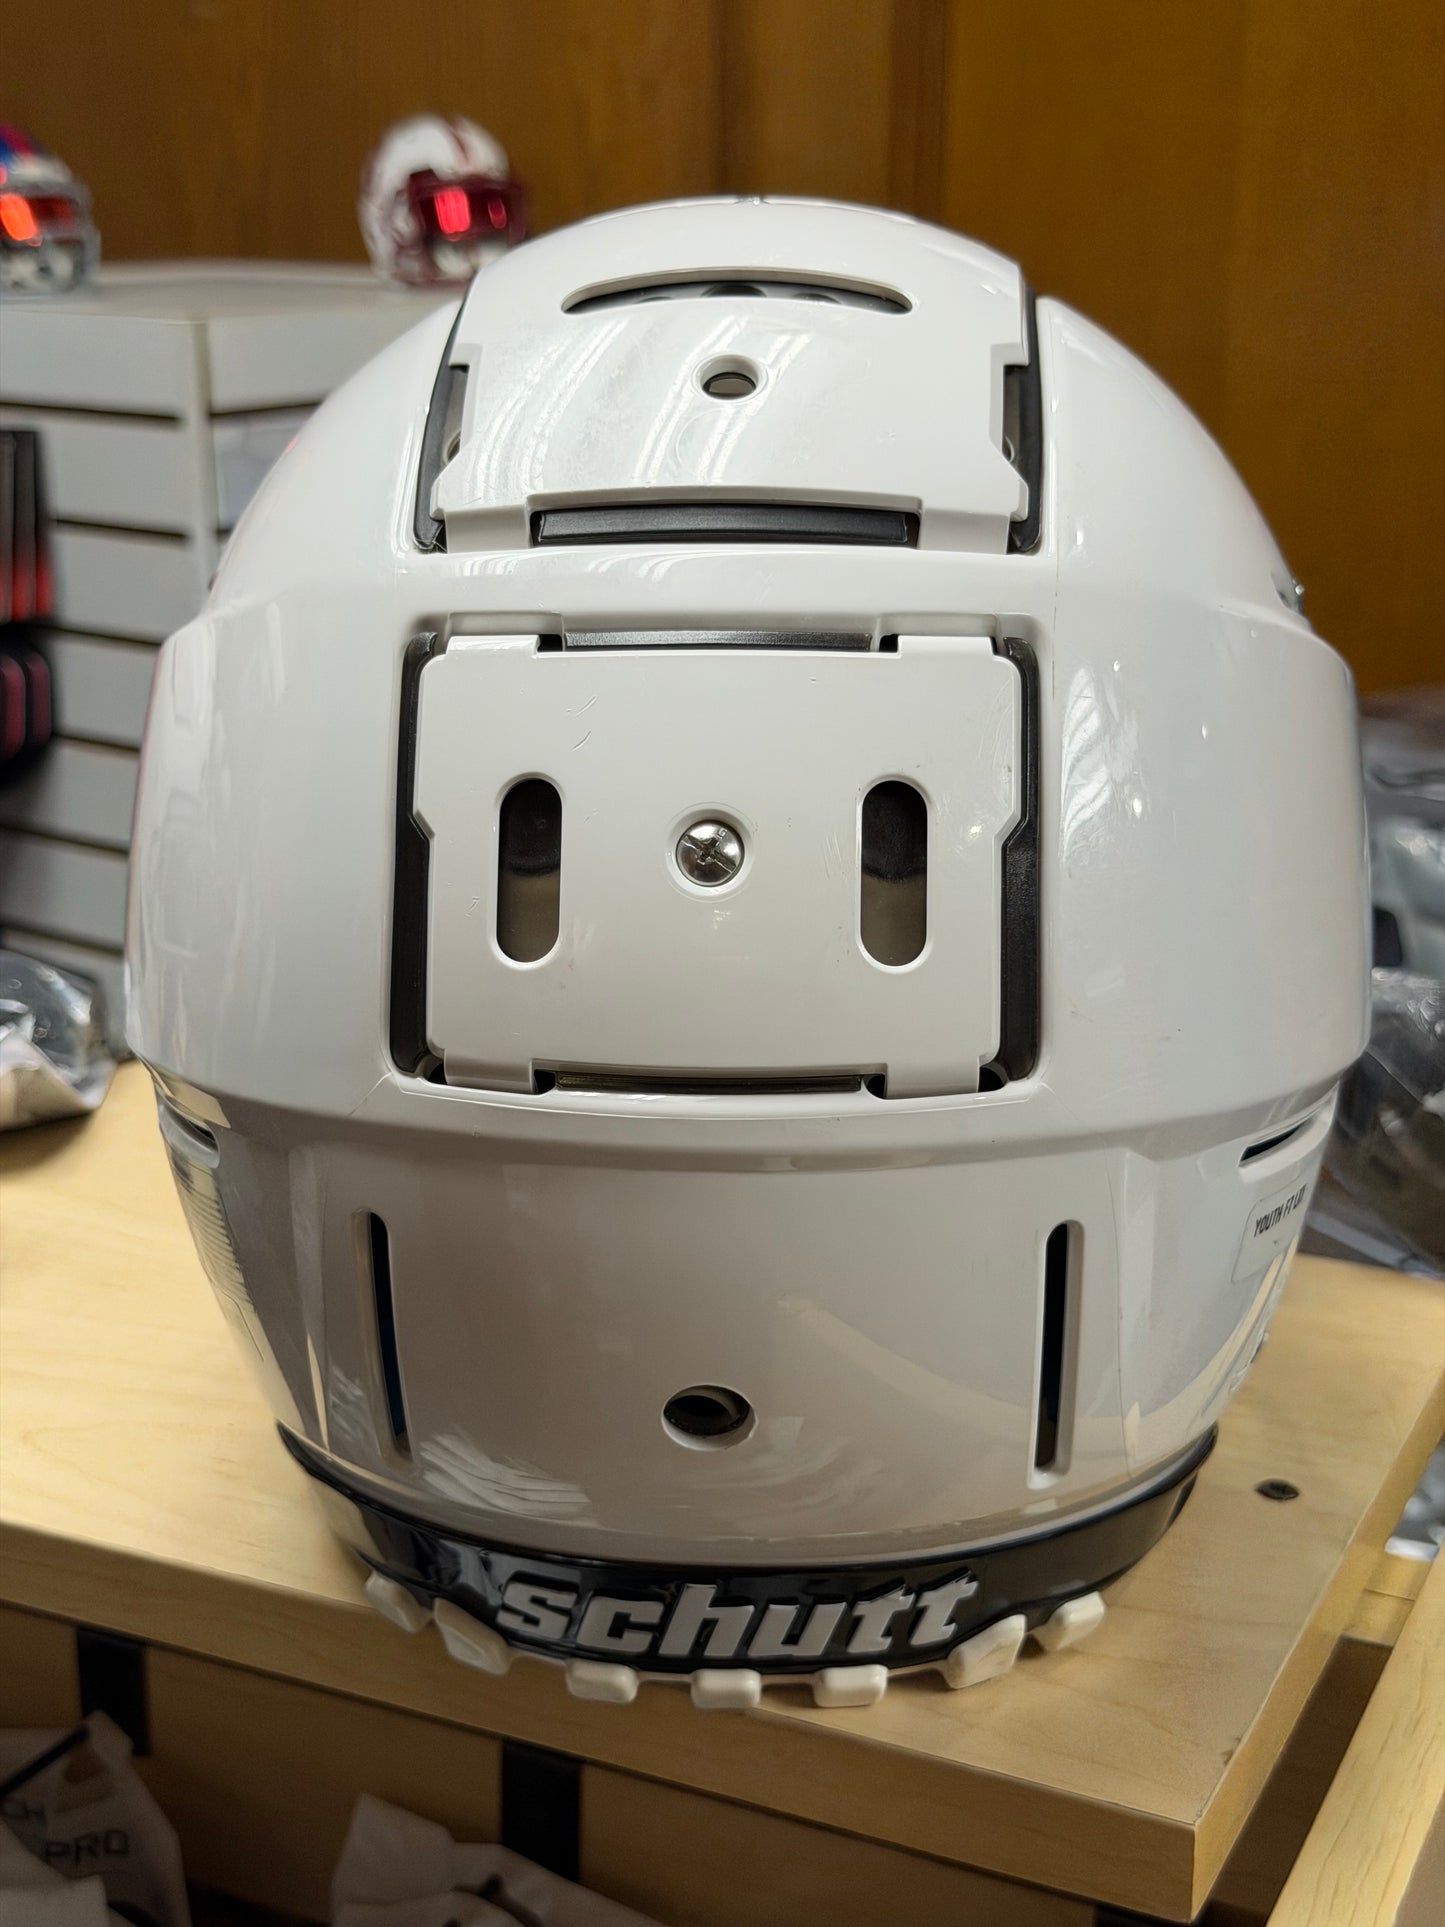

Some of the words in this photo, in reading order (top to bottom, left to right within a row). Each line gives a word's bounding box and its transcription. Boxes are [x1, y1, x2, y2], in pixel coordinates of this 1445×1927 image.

[1254, 1203, 1284, 1237] YOUTH
[496, 1568, 980, 1657] schutt
[44, 1829, 130, 1867] PRO
